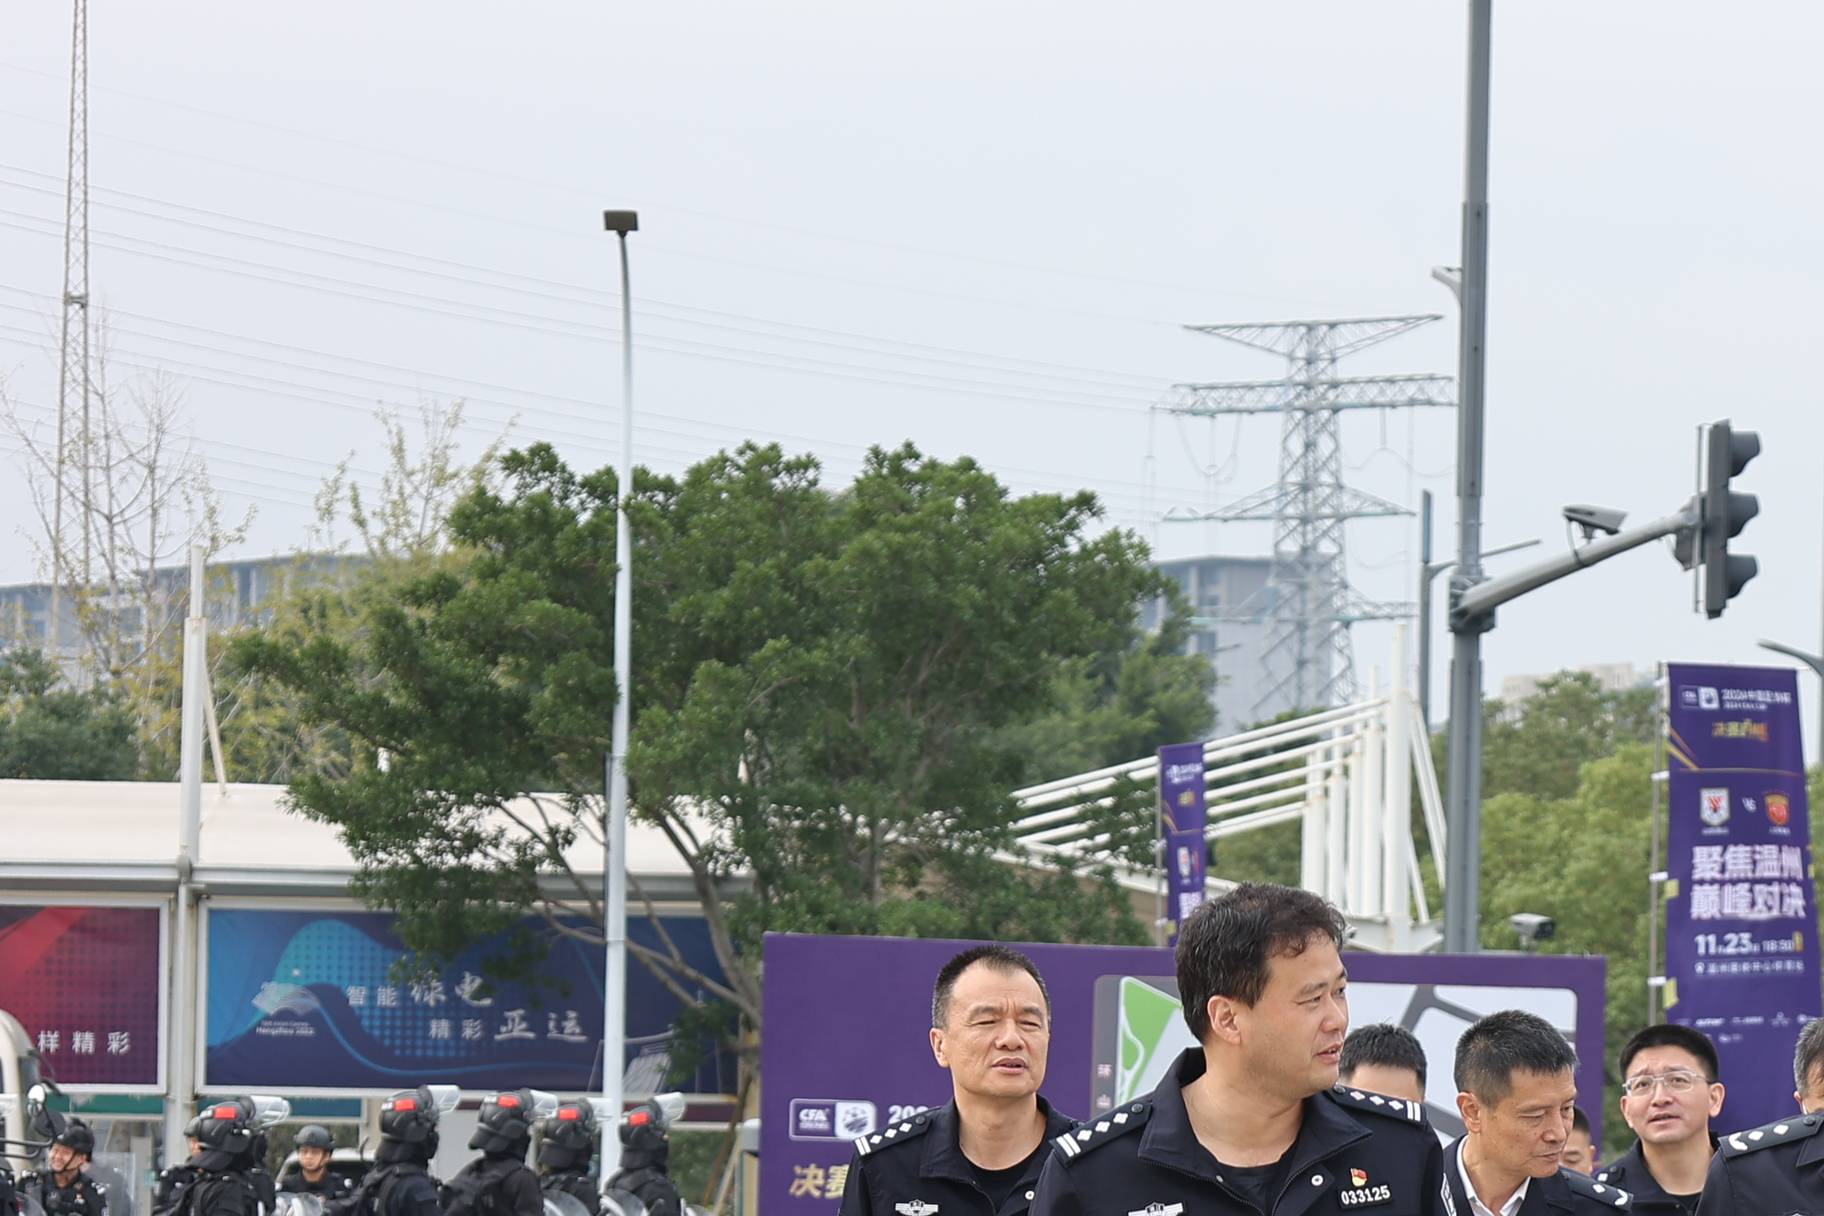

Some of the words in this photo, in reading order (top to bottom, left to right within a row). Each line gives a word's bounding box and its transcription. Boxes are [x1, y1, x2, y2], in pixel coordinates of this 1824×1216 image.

[1691, 844, 1803, 880] 聚焦温州
[1690, 881, 1806, 919] 巅峰对决
[37, 1030, 132, 1054] 样精彩
[428, 1008, 588, 1042] 精彩亚运
[1340, 1185, 1391, 1206] 033125
